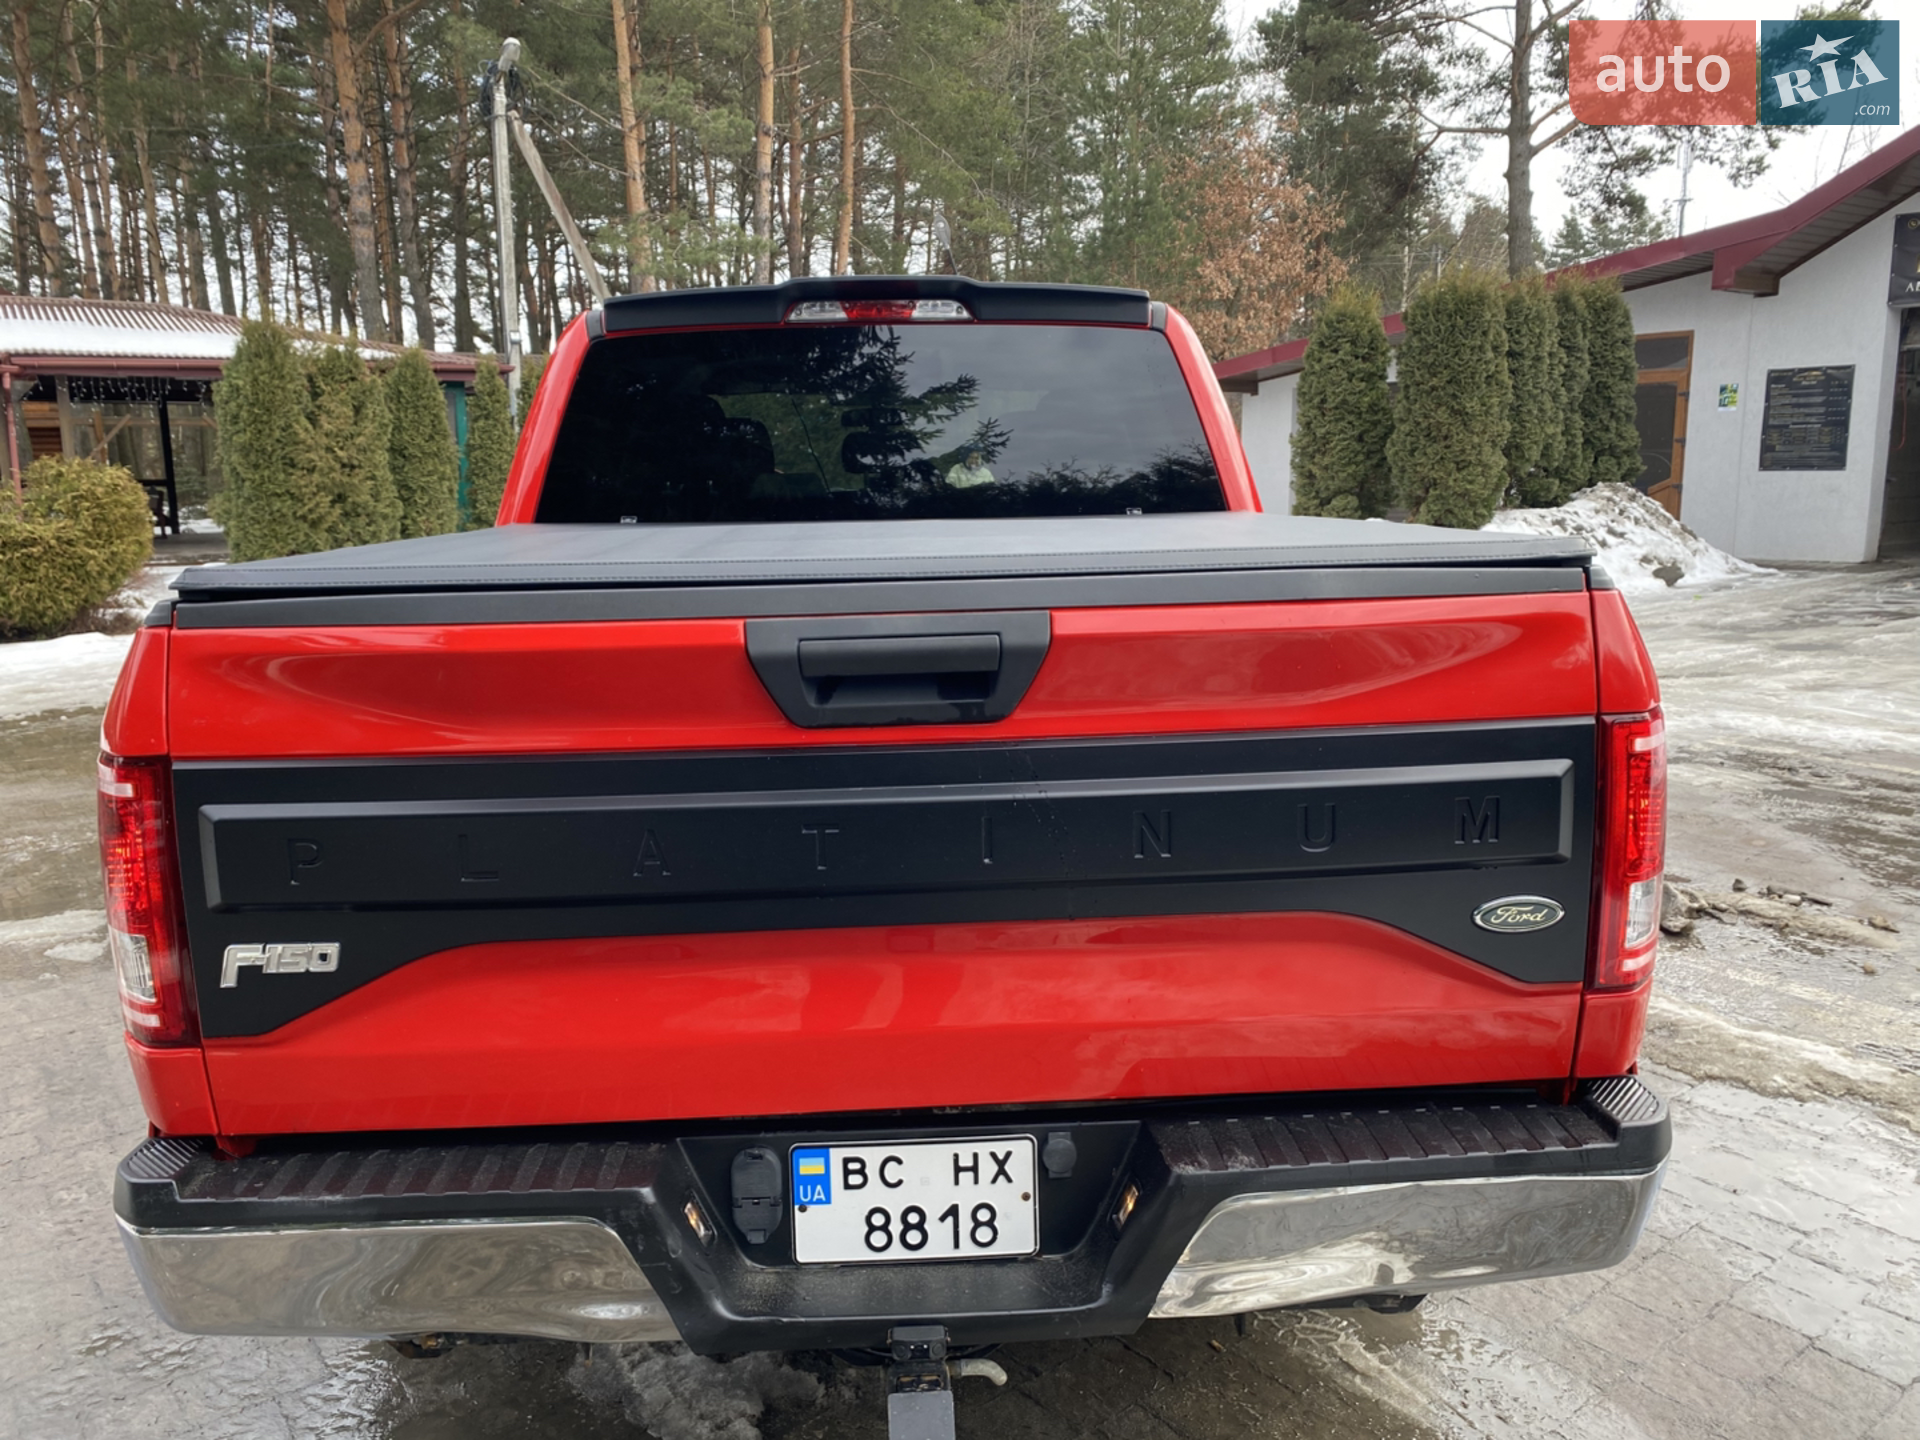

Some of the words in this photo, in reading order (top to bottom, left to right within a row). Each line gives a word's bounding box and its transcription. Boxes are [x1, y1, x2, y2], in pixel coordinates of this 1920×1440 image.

[287, 796, 1501, 885] PLATINUM
[1491, 906, 1547, 923] Ford
[841, 1155, 904, 1190] BC
[952, 1150, 1013, 1186] HX
[800, 1184, 826, 1202] UA
[864, 1202, 999, 1253] 8818
